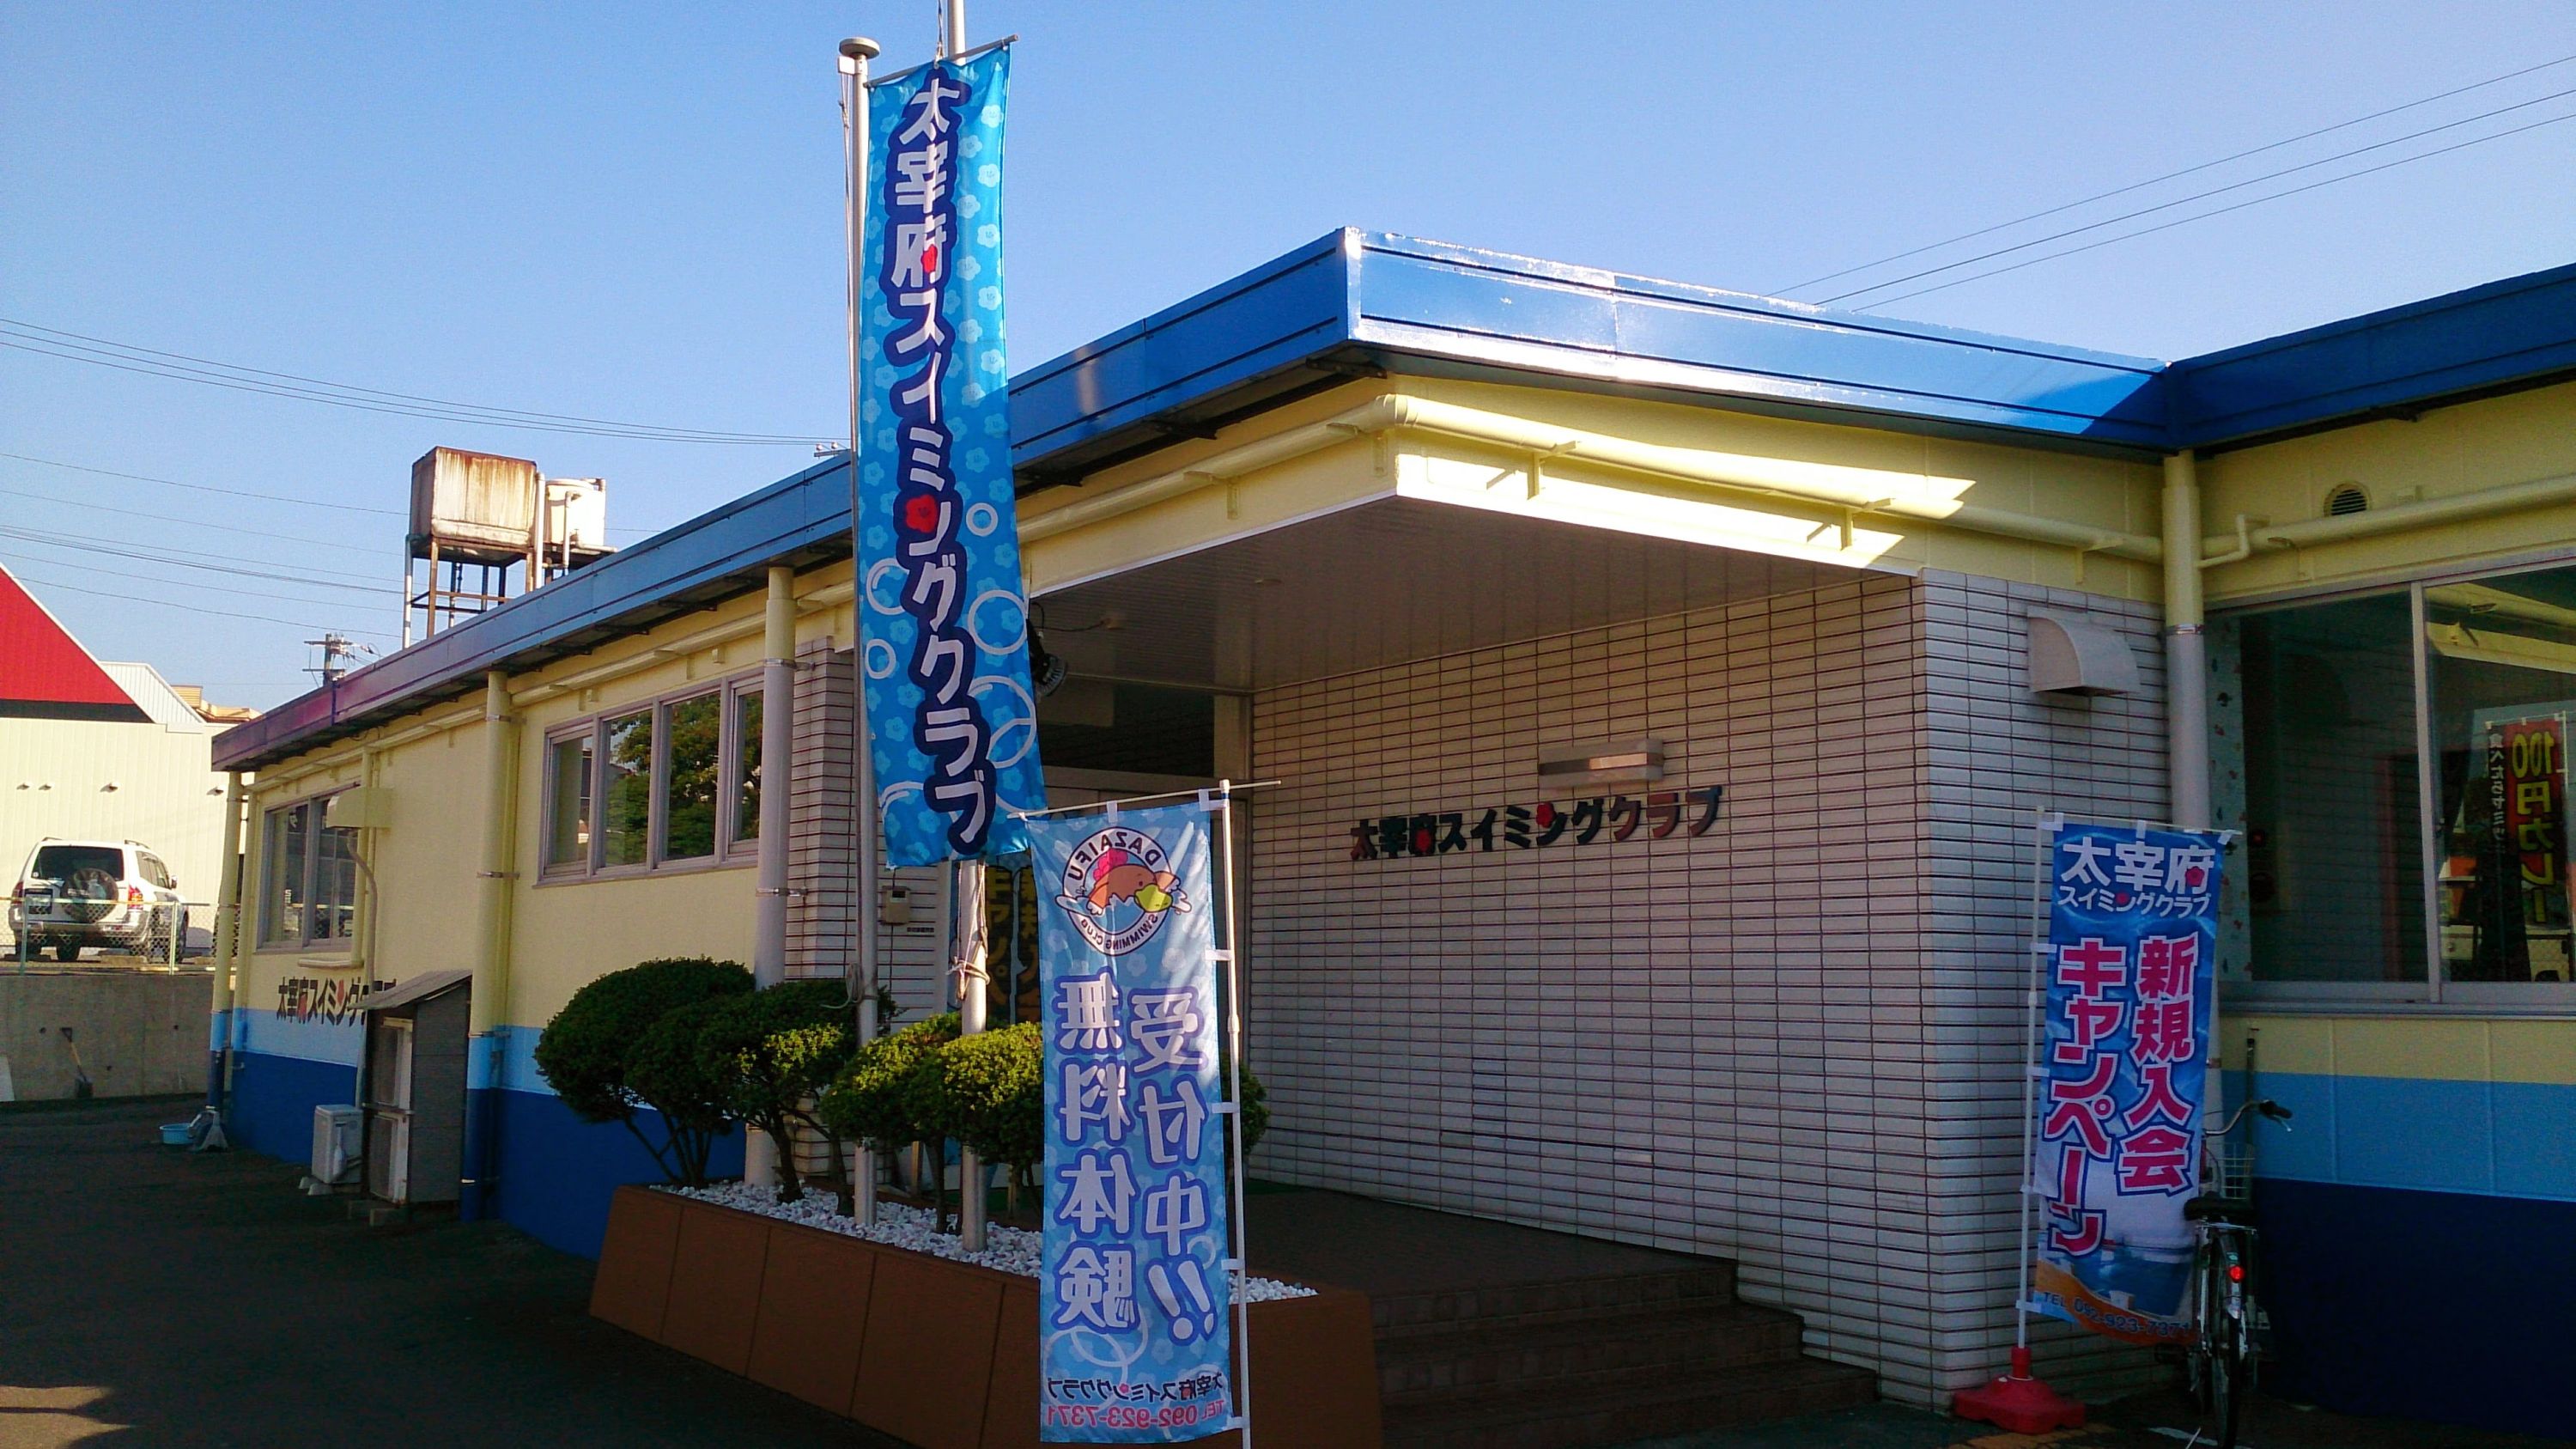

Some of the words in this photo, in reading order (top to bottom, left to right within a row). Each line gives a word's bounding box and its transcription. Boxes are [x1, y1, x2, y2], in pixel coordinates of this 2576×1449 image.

[891, 78, 985, 844] 太宰府スイミングクラブ
[1350, 785, 1722, 859] 太宰府スイミングクラブ
[2057, 885, 2212, 919] スイミングクラブ
[2061, 837, 2216, 895] 太宰府
[2044, 938, 2127, 1257] キャンペーン
[2117, 932, 2198, 1196] 新規入会
[2044, 1292, 2065, 1307] TEL
[2074, 1297, 2190, 1337] 092-923-7371
